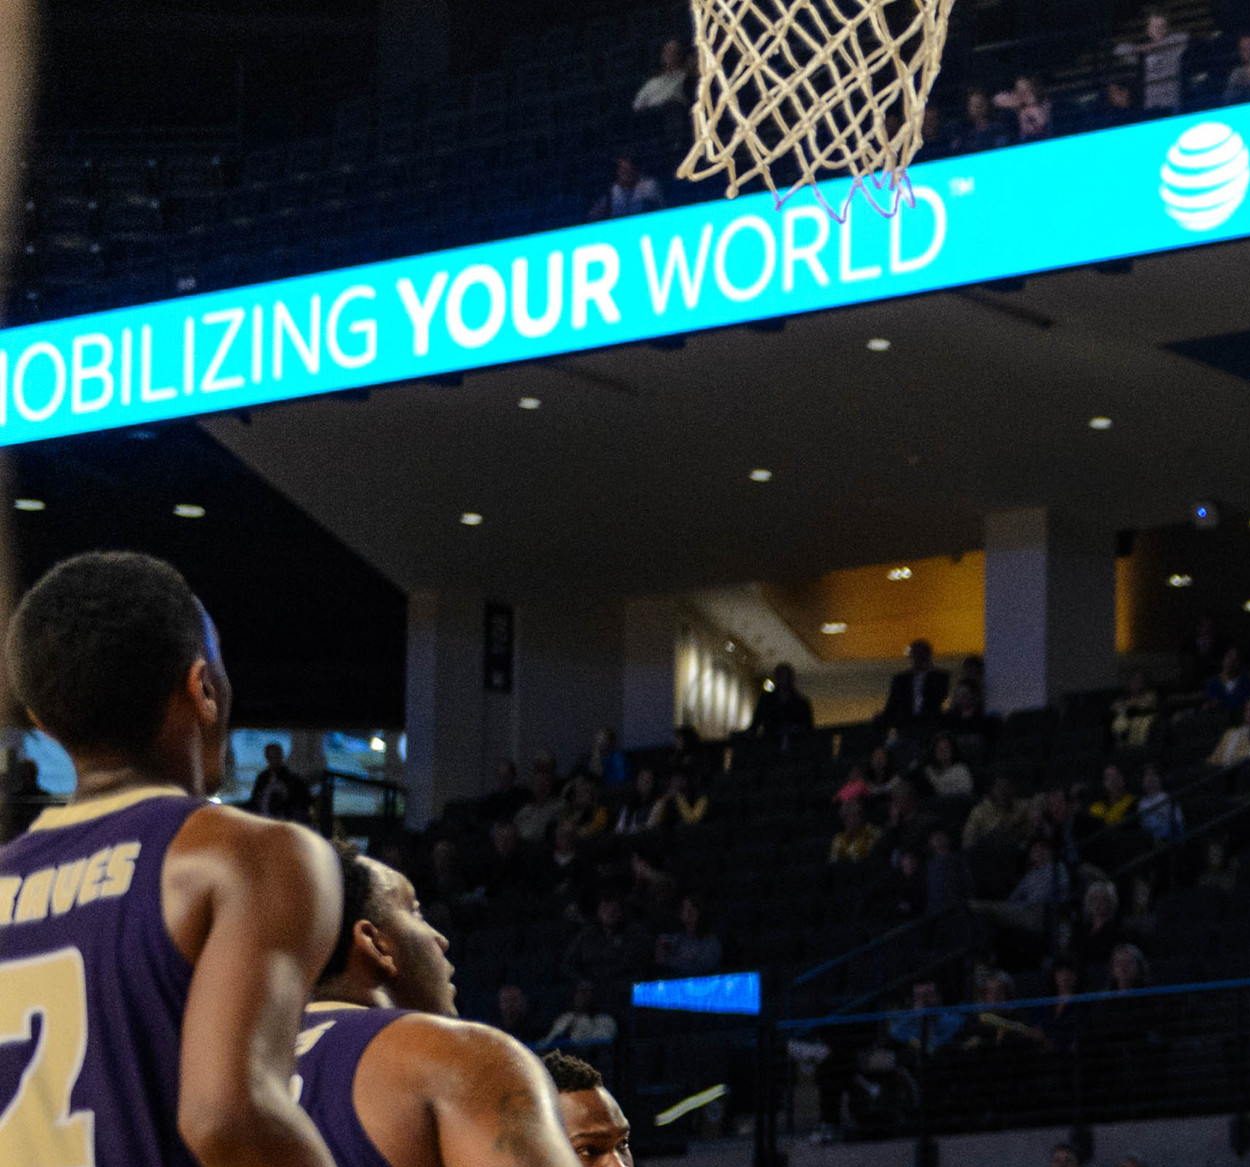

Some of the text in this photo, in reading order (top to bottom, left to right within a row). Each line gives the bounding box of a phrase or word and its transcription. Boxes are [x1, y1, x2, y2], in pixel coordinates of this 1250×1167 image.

[0, 285, 377, 426] OBILIZING
[396, 243, 621, 357] YOUR
[641, 186, 948, 315] WORLD
